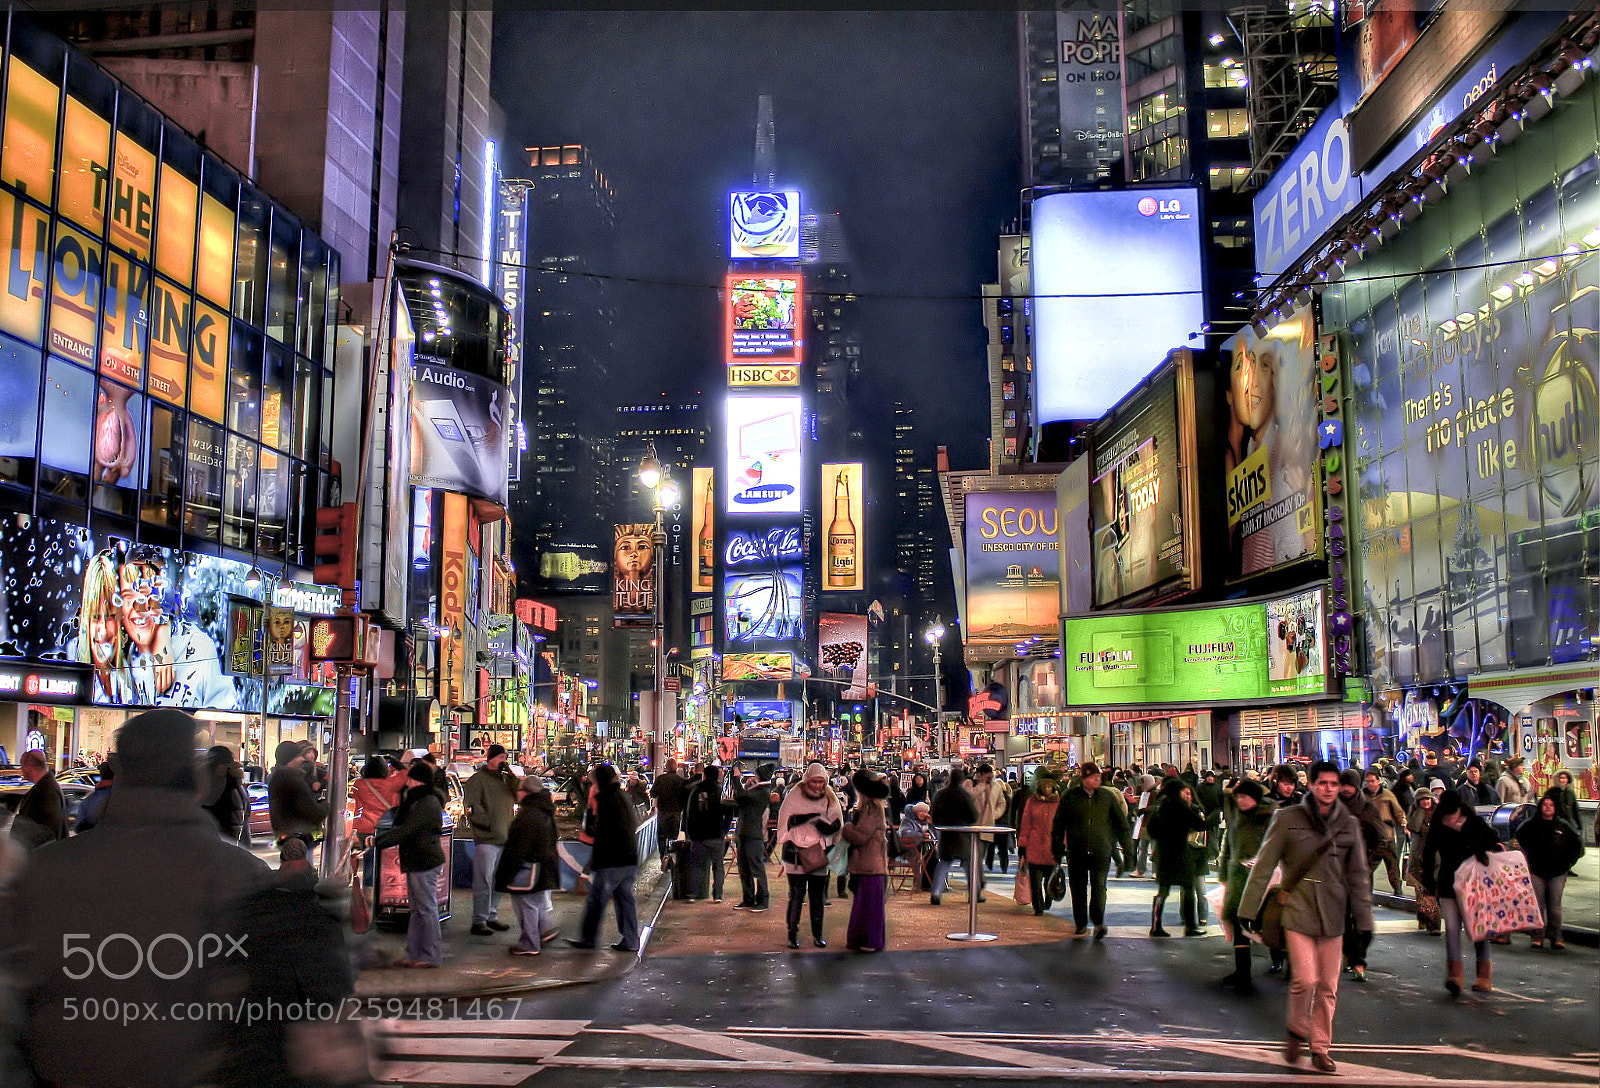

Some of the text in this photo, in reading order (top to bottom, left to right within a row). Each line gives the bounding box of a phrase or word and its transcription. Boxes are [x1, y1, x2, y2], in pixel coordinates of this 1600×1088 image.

[1077, 16, 1119, 42] MA
[1066, 73, 1086, 82] ON
[90, 160, 152, 239] THE
[1160, 199, 1181, 212] LG
[1260, 117, 1349, 274] ZERO
[8, 178, 120, 319] LION
[502, 210, 521, 310] TIMES
[121, 247, 217, 368] KING
[53, 333, 94, 359] ENTRANCE
[105, 357, 140, 381] ON 45TH
[731, 369, 773, 382] HSBC
[150, 376, 171, 395] STREET
[1405, 382, 1453, 424] There's
[1427, 387, 1515, 453] no place
[1477, 439, 1517, 479] like
[740, 489, 789, 499] SAMSUNG
[1131, 478, 1160, 516] TODAY
[1228, 464, 1266, 517] skins
[1264, 497, 1294, 526] MONDAY
[672, 492, 682, 565] OVOTEL
[982, 543, 1014, 552] UNESCO
[1016, 542, 1034, 551] CITY
[1036, 542, 1047, 551] OF
[1330, 506, 1347, 610] BABIES
[616, 580, 651, 592] KING
[616, 591, 653, 607] TUT
[270, 643, 292, 652] KING
[1080, 650, 1133, 664] FUJIFILM
[1188, 641, 1235, 655] FUJIFILM
